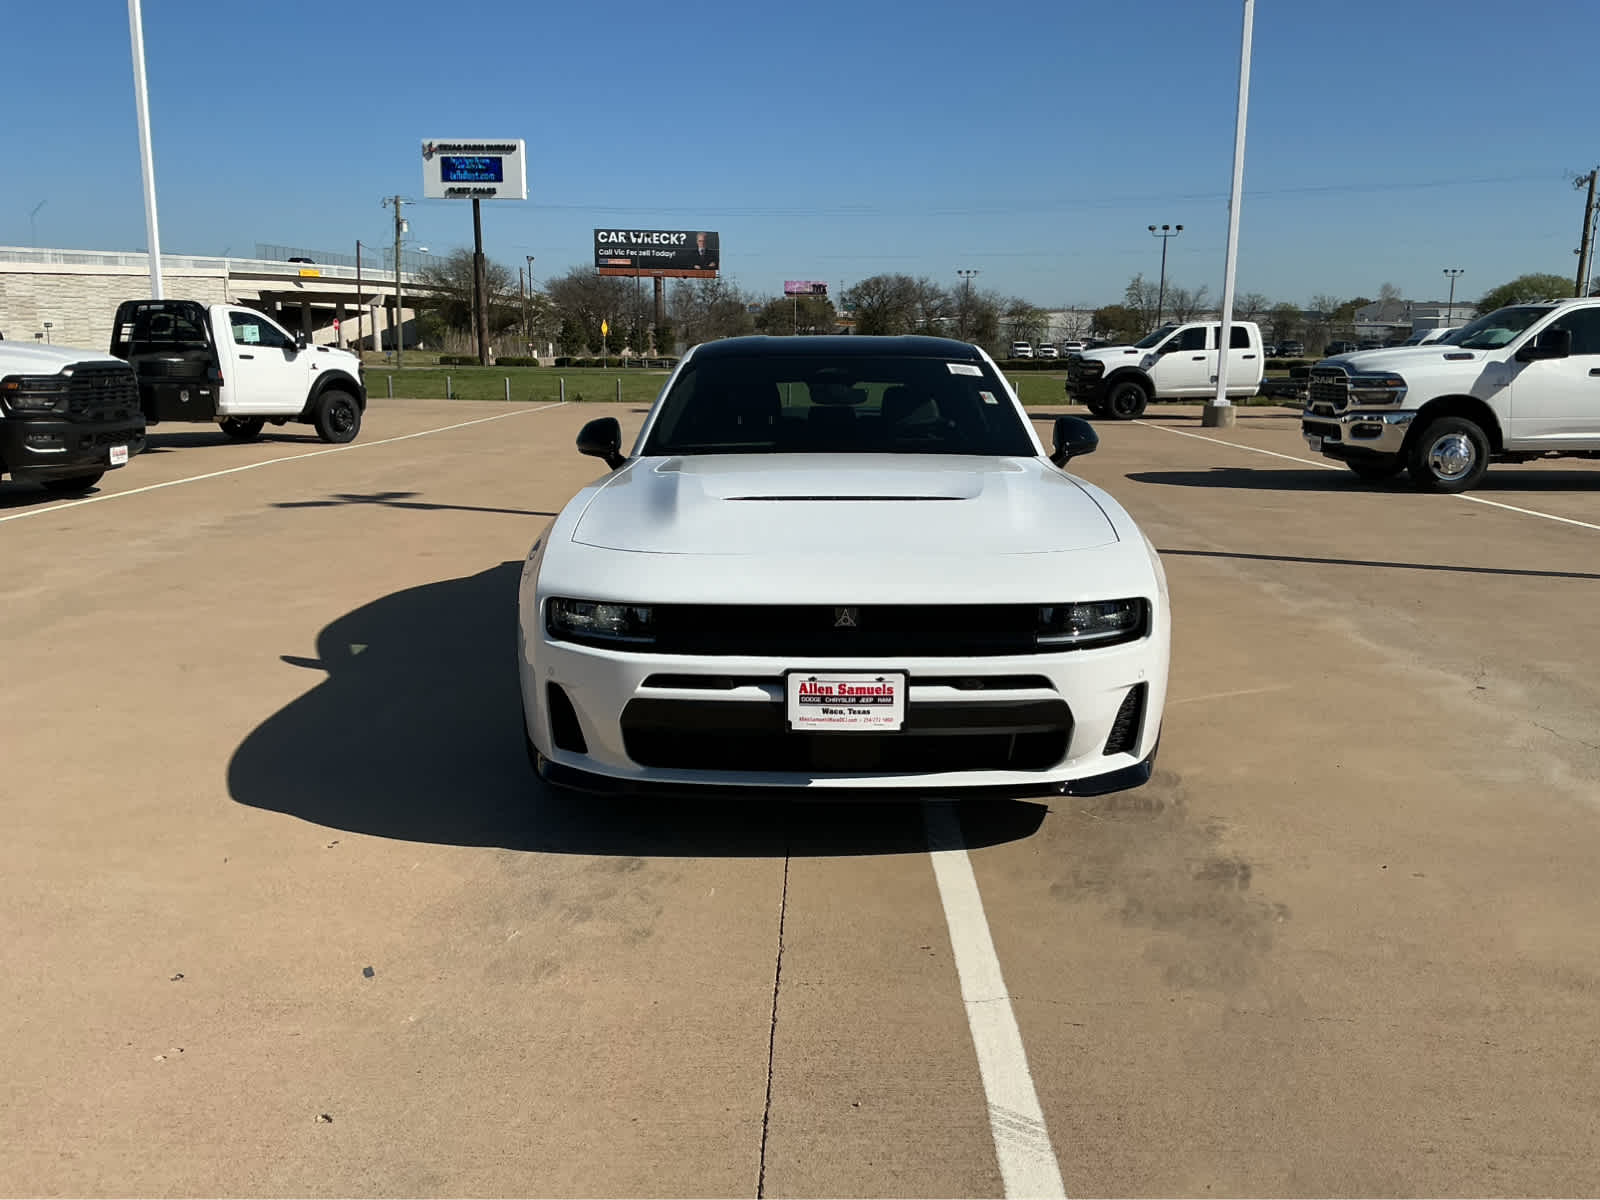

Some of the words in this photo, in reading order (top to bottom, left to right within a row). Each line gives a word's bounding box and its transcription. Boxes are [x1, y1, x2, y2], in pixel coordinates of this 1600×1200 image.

[448, 187, 471, 195] FLEET
[472, 187, 497, 195] SALES
[597, 231, 627, 243] CAR
[629, 232, 687, 245] WRECK?
[598, 248, 613, 256] Call
[614, 248, 626, 256] Vic
[652, 249, 676, 259] Today!
[799, 682, 834, 695] Allen
[838, 683, 894, 695] Samuels
[821, 707, 846, 716] Waco,
[847, 707, 871, 715] Texas
